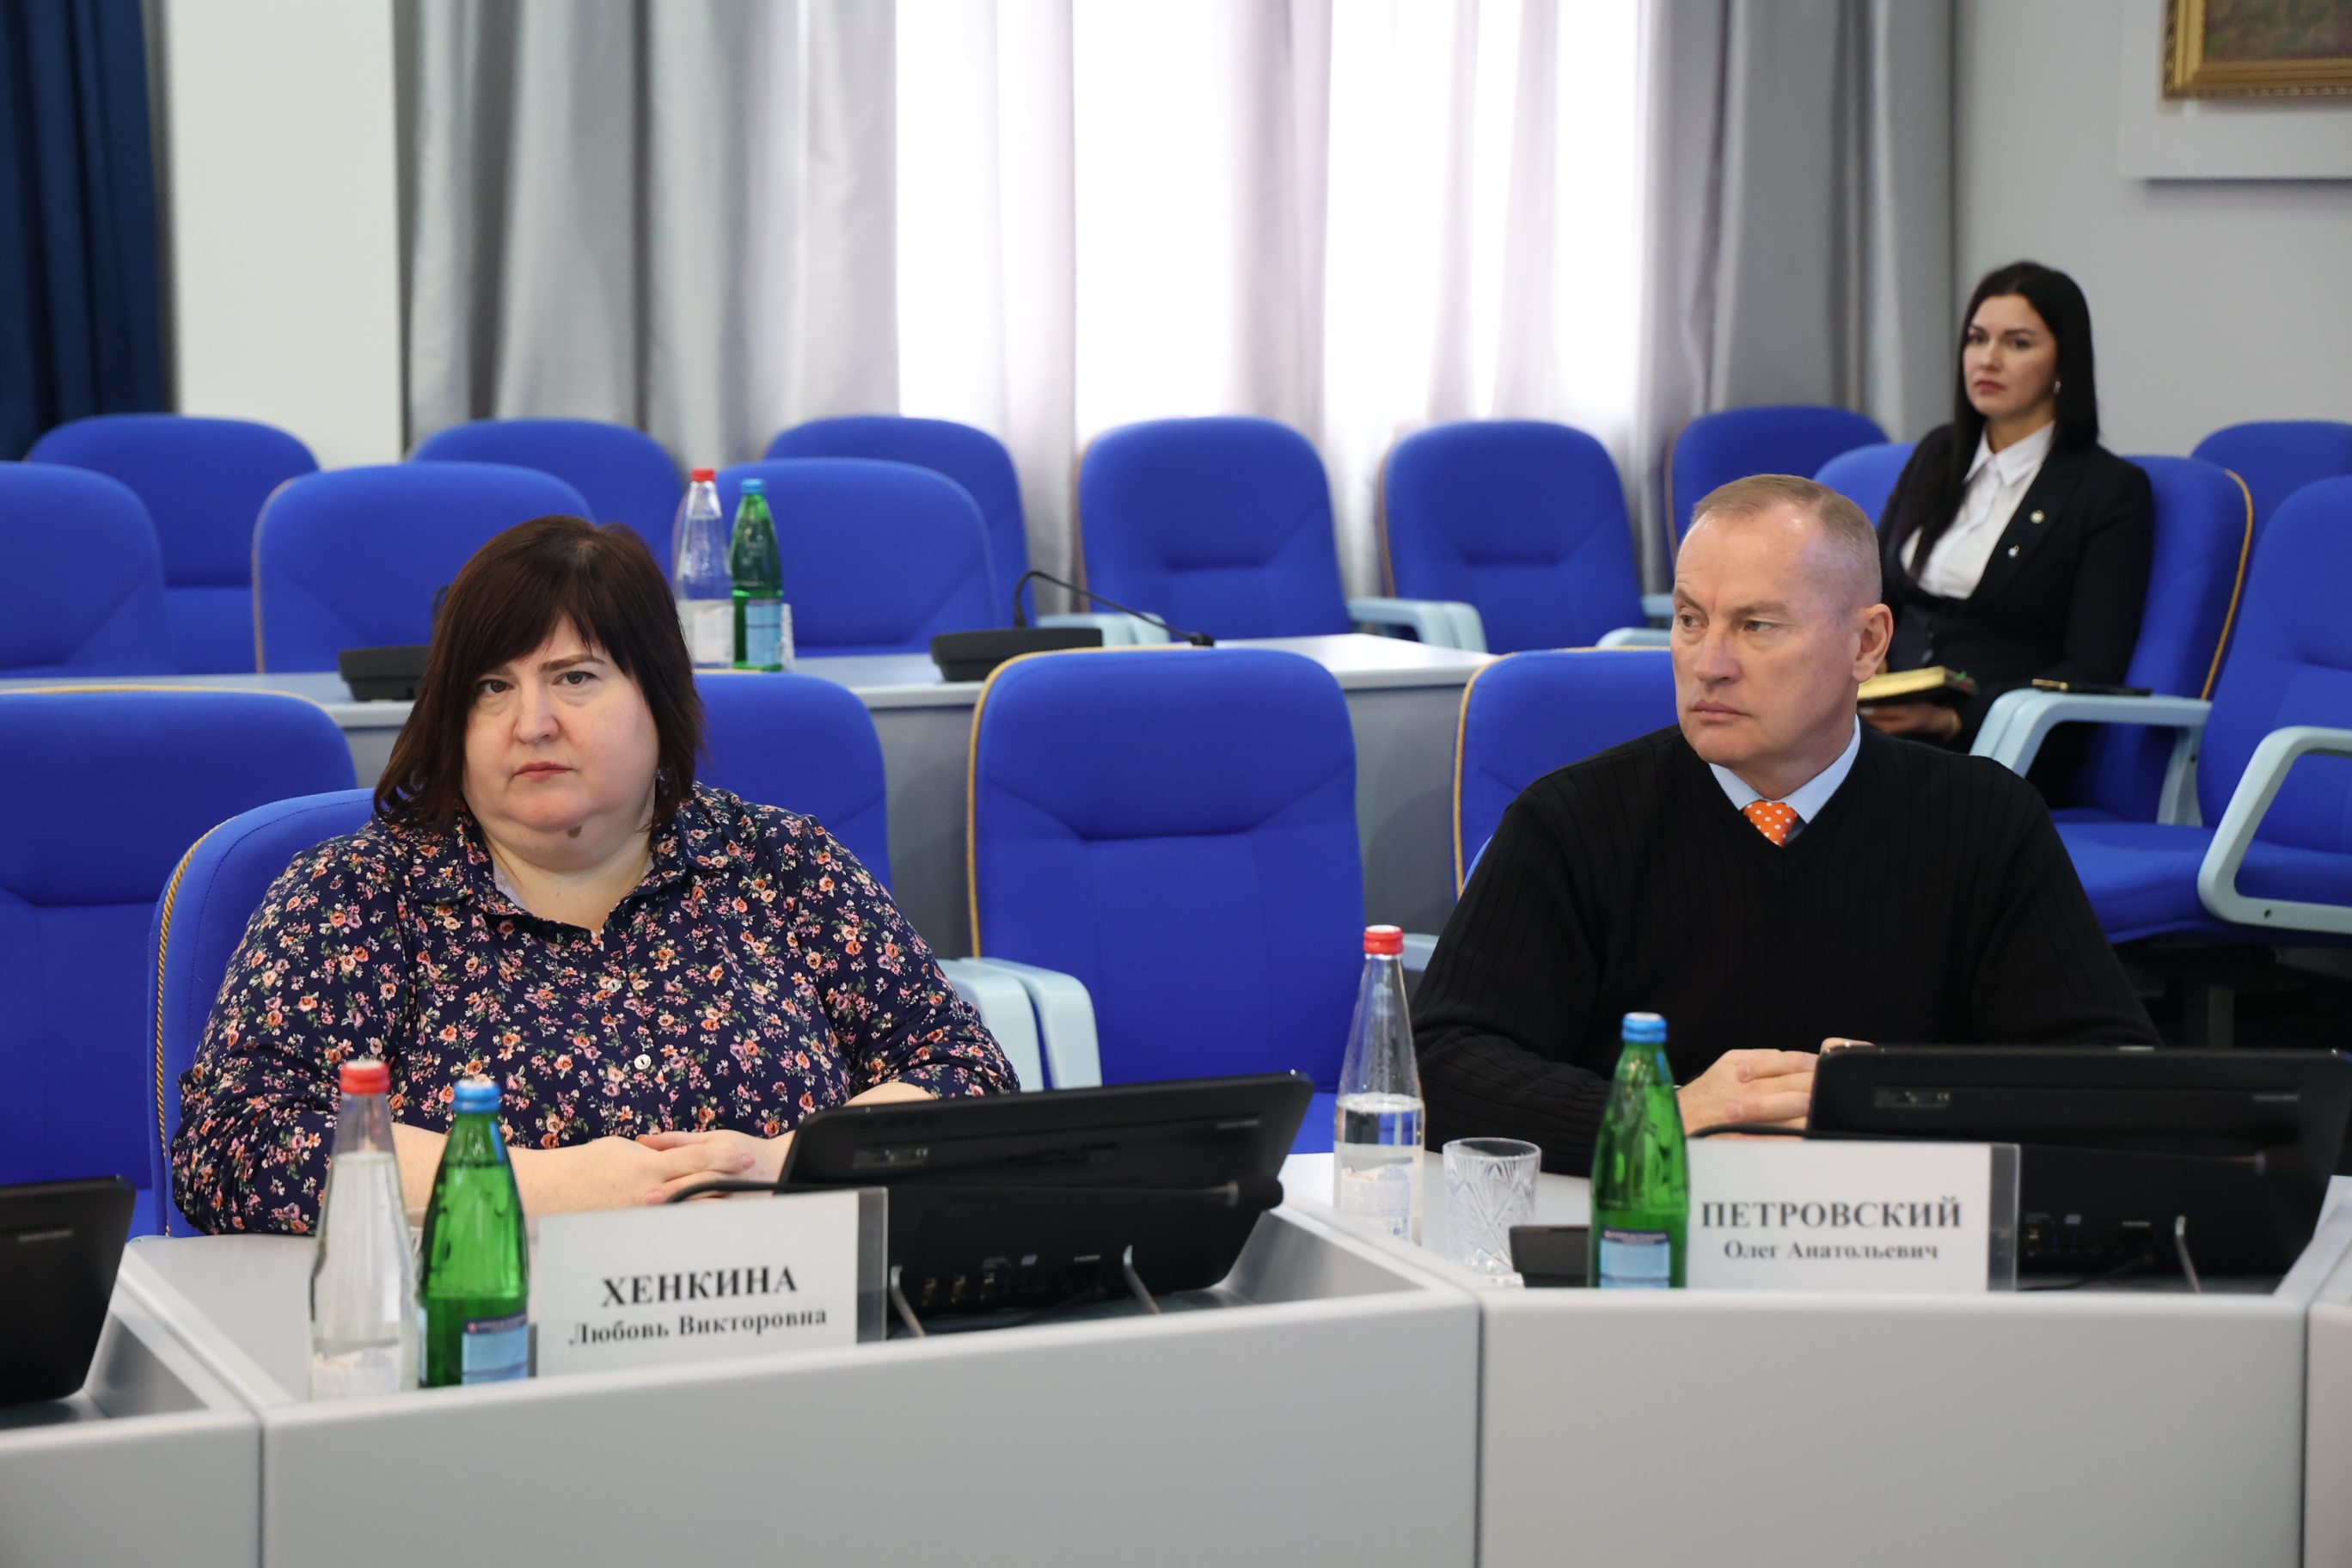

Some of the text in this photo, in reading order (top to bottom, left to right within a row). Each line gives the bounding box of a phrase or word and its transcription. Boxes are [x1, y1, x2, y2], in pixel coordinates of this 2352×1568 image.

[1700, 1195, 1963, 1229] ПЕТРОВСКИЙ
[1722, 1240, 1939, 1260] Олег Анатольевич
[601, 1265, 798, 1308] ХЕНКИНА
[568, 1309, 828, 1347] Любовь Викторовна
